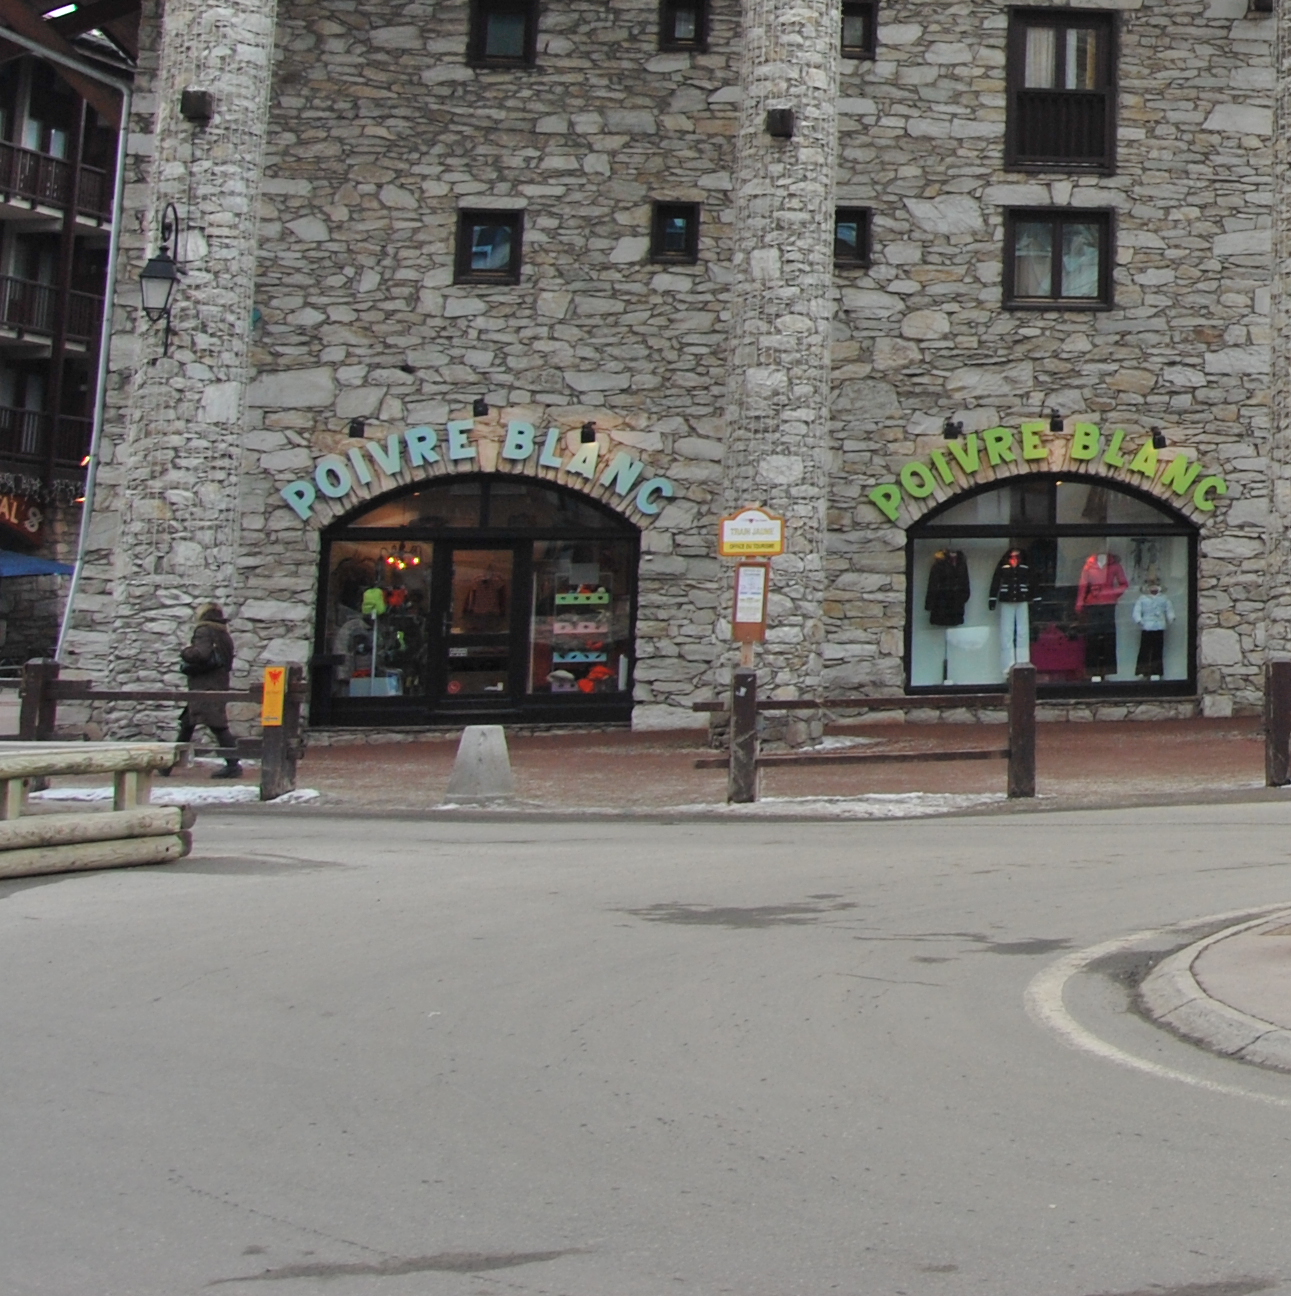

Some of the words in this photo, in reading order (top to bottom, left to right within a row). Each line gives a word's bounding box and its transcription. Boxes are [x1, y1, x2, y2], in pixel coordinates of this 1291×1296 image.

[0, 495, 18, 523] AL
[280, 420, 476, 521] POIVRE
[502, 421, 674, 515] BLANC
[868, 421, 1049, 522] POIVRE
[1071, 422, 1228, 512] BLANC
